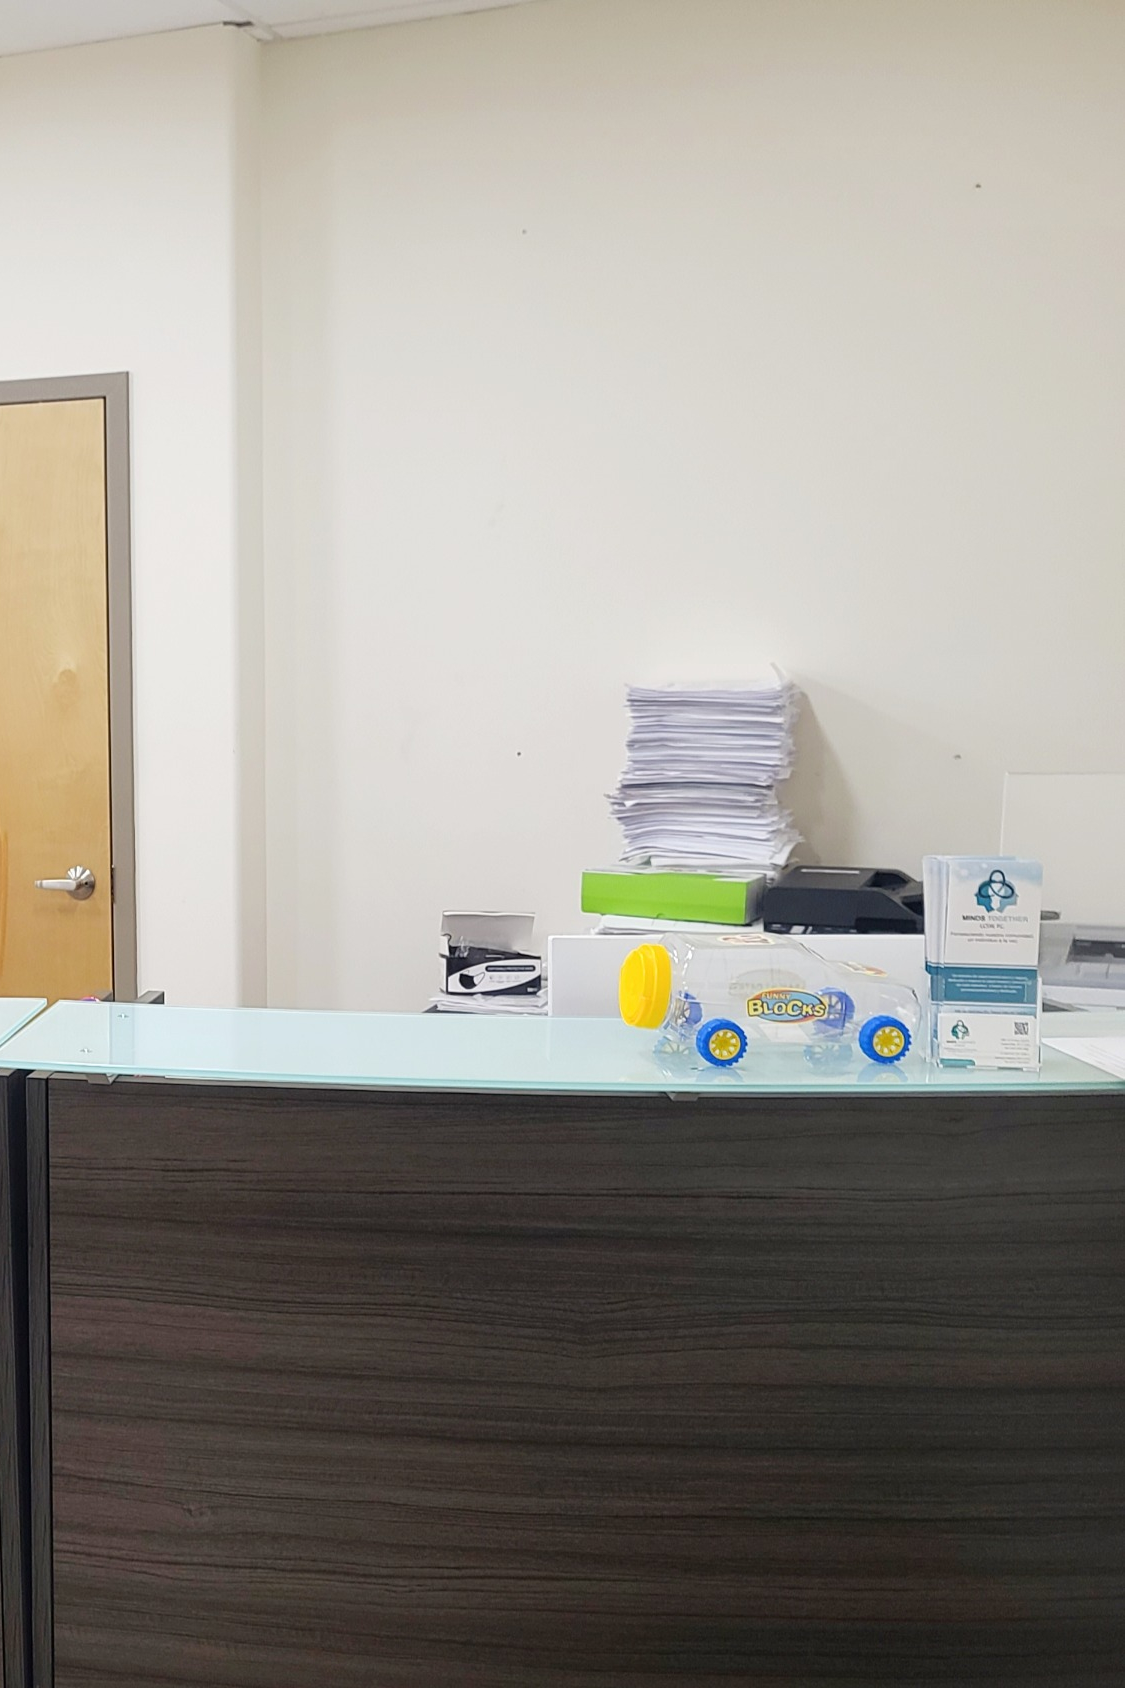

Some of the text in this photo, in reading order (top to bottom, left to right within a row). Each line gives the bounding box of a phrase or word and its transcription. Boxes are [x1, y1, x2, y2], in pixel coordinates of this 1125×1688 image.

[988, 915, 1029, 923] TOGETHER
[762, 992, 790, 1000] FUNNY
[748, 1000, 825, 1016] BLOCKS
